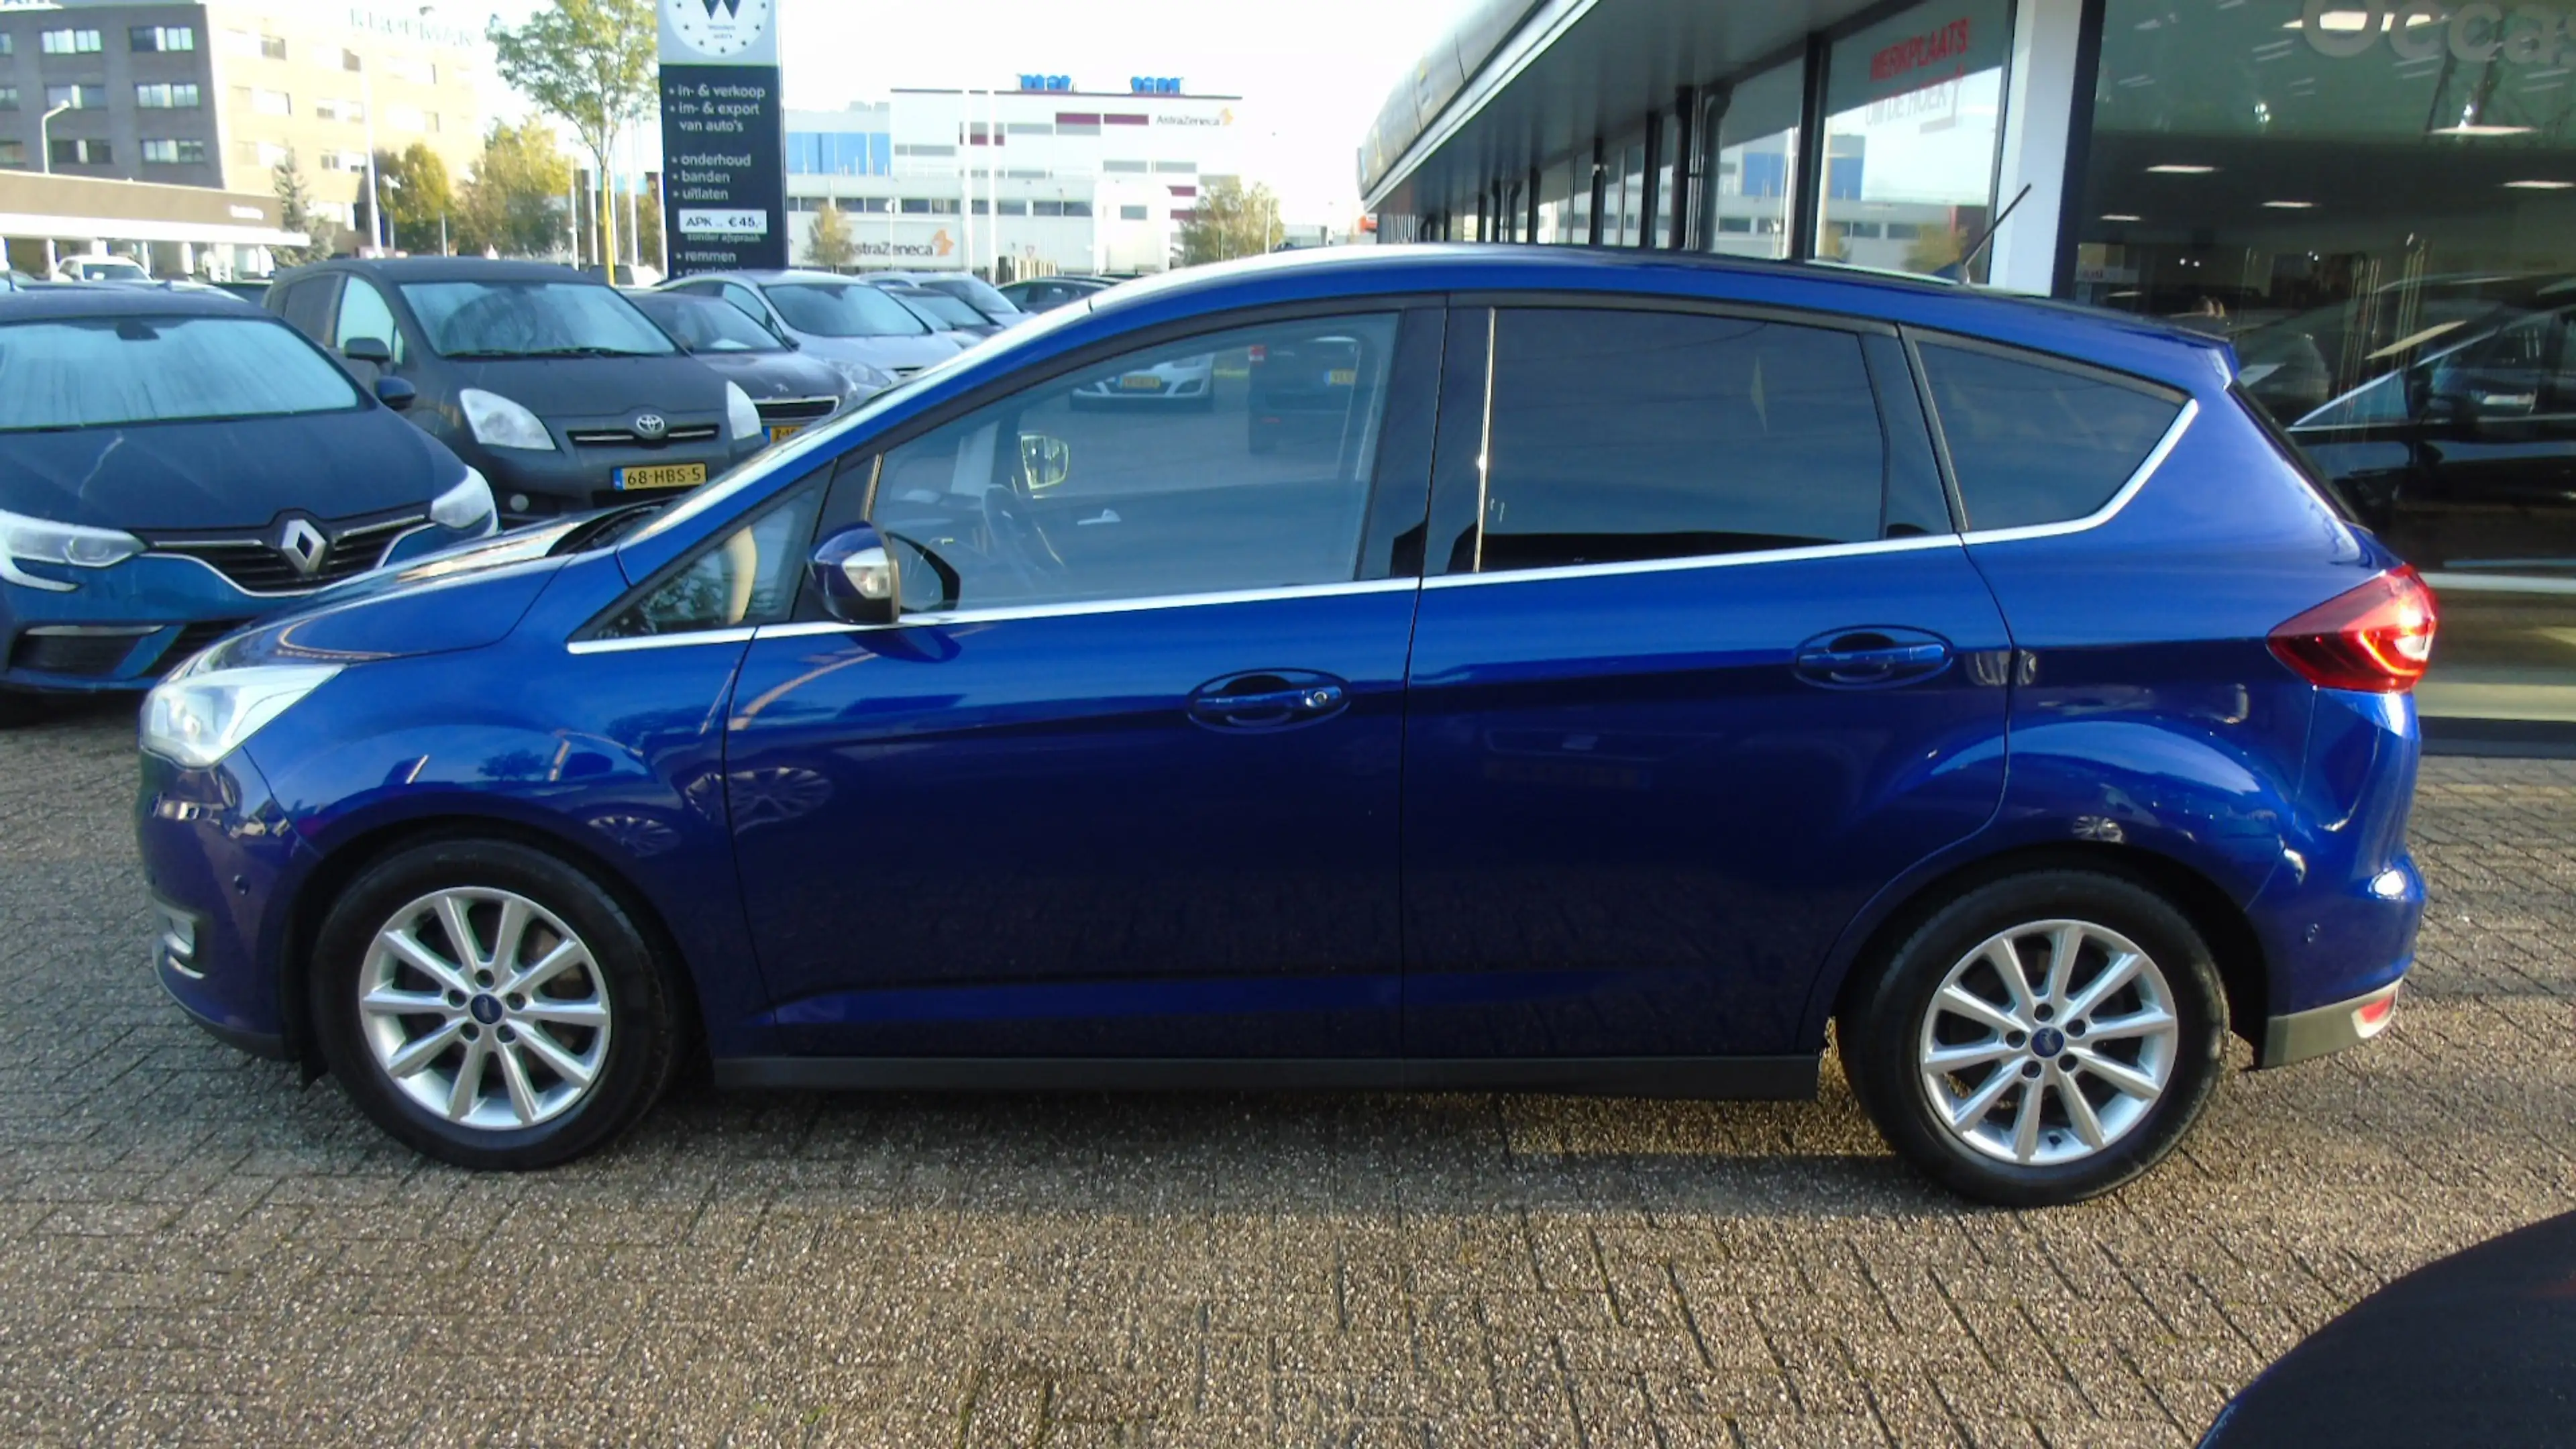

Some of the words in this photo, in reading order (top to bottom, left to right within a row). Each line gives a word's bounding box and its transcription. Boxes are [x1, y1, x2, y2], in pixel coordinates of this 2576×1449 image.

[2302, 0, 2575, 65] Occa
[1872, 17, 1969, 80] WERKPLAATS
[698, 83, 710, 97] &
[712, 84, 765, 101] verkoop
[679, 101, 699, 114] im-
[702, 101, 714, 115] &
[717, 102, 760, 117] export
[679, 120, 702, 131] van
[706, 119, 744, 132] auto's
[681, 152, 751, 167] onderhoud
[682, 170, 731, 183] banden
[682, 186, 729, 201] uitlaten
[686, 216, 712, 227] APK
[685, 250, 737, 263] remmen
[627, 467, 702, 486] 68-HBS-5
